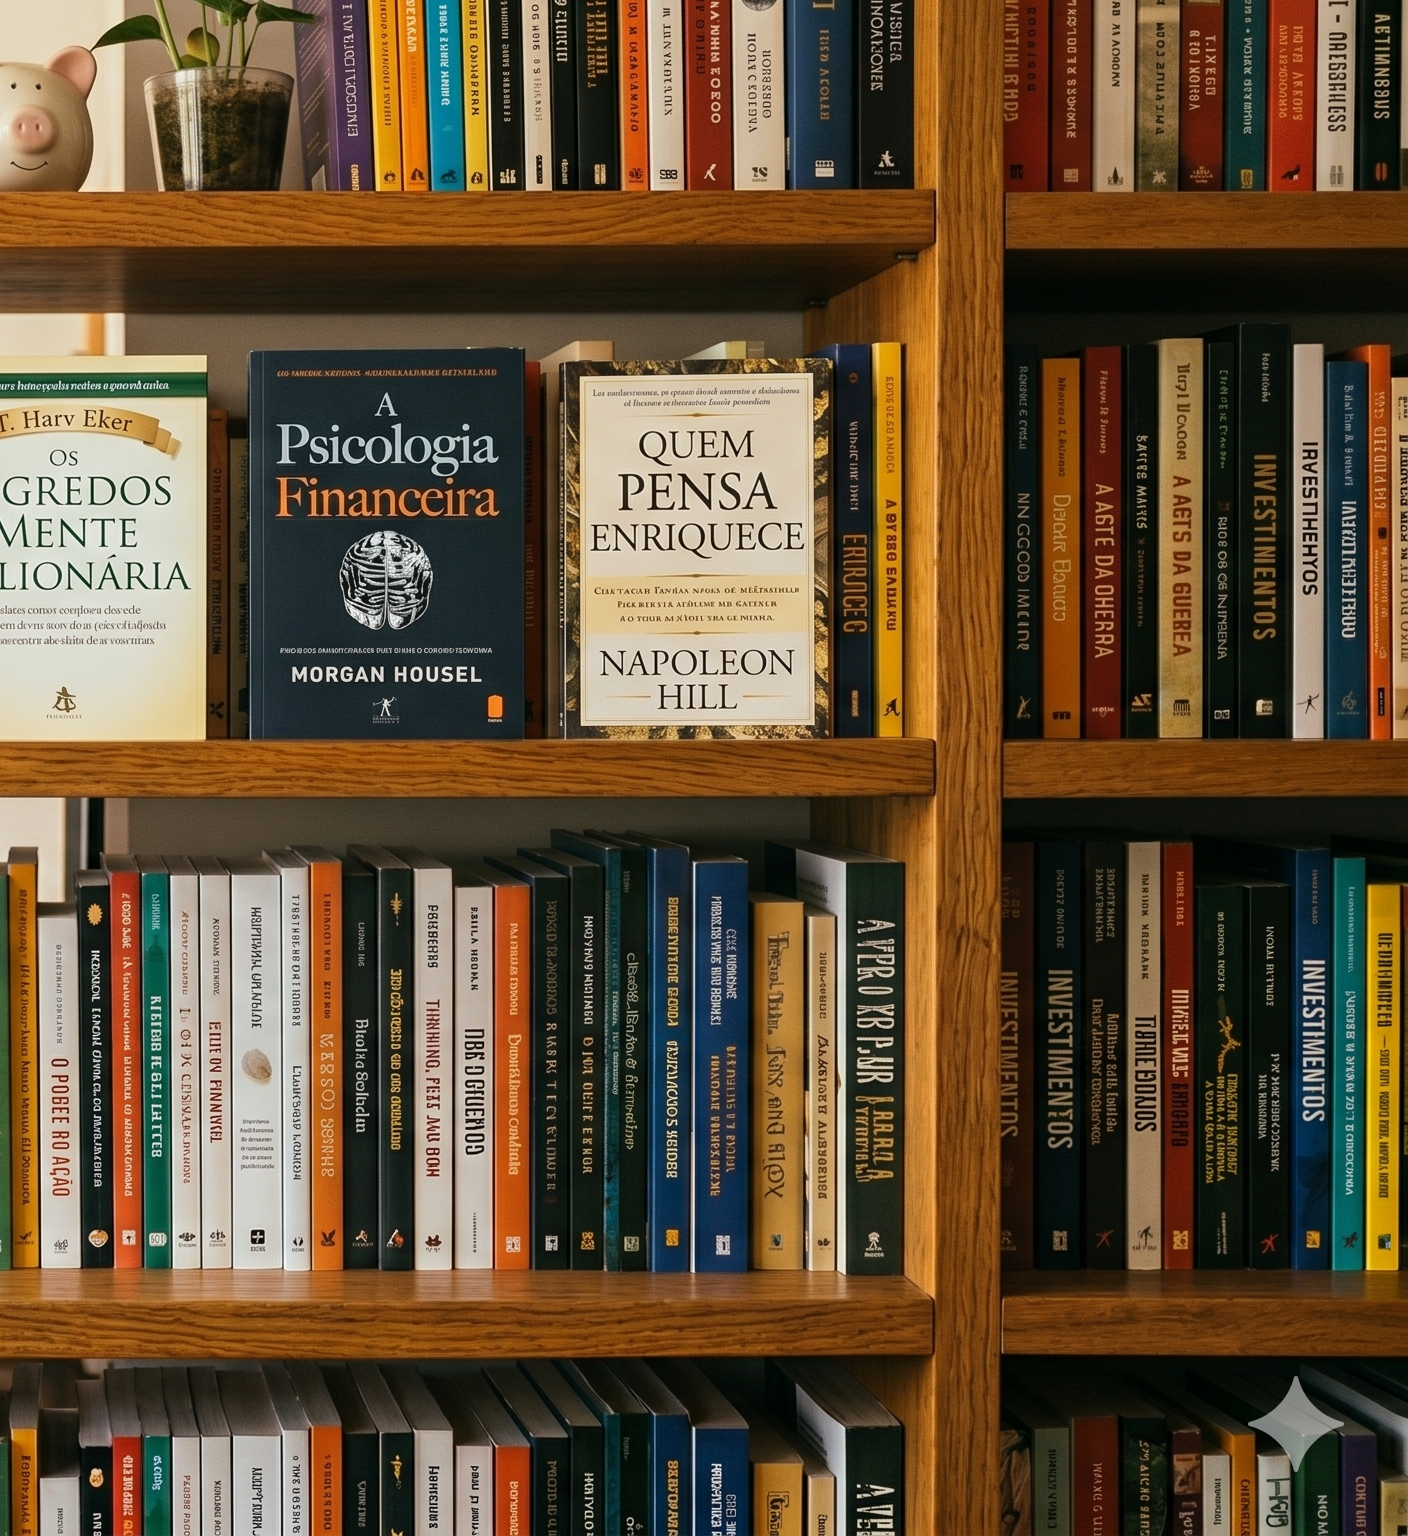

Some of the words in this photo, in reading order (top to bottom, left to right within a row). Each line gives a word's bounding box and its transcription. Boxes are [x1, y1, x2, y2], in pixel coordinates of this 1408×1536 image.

[374, 392, 398, 417] A
[22, 410, 75, 430] Harv
[83, 409, 133, 432] Eker
[49, 449, 79, 467] OS
[276, 423, 499, 477] Psicologia
[638, 430, 755, 466] QUEM
[618, 472, 778, 511] PENSA
[1095, 483, 1115, 496] A
[1173, 475, 1192, 488] A
[275, 477, 500, 517] Financeira
[590, 522, 806, 560] ENRIQUECE
[1173, 551, 1192, 576] DA
[291, 666, 385, 683] MORGAN
[394, 666, 483, 683] HOUSEL
[600, 648, 796, 677] NAPOLEON
[657, 684, 738, 710] HILL
[1302, 959, 1326, 1122] INVESTIMENTOS
[51, 1058, 69, 1068] O
